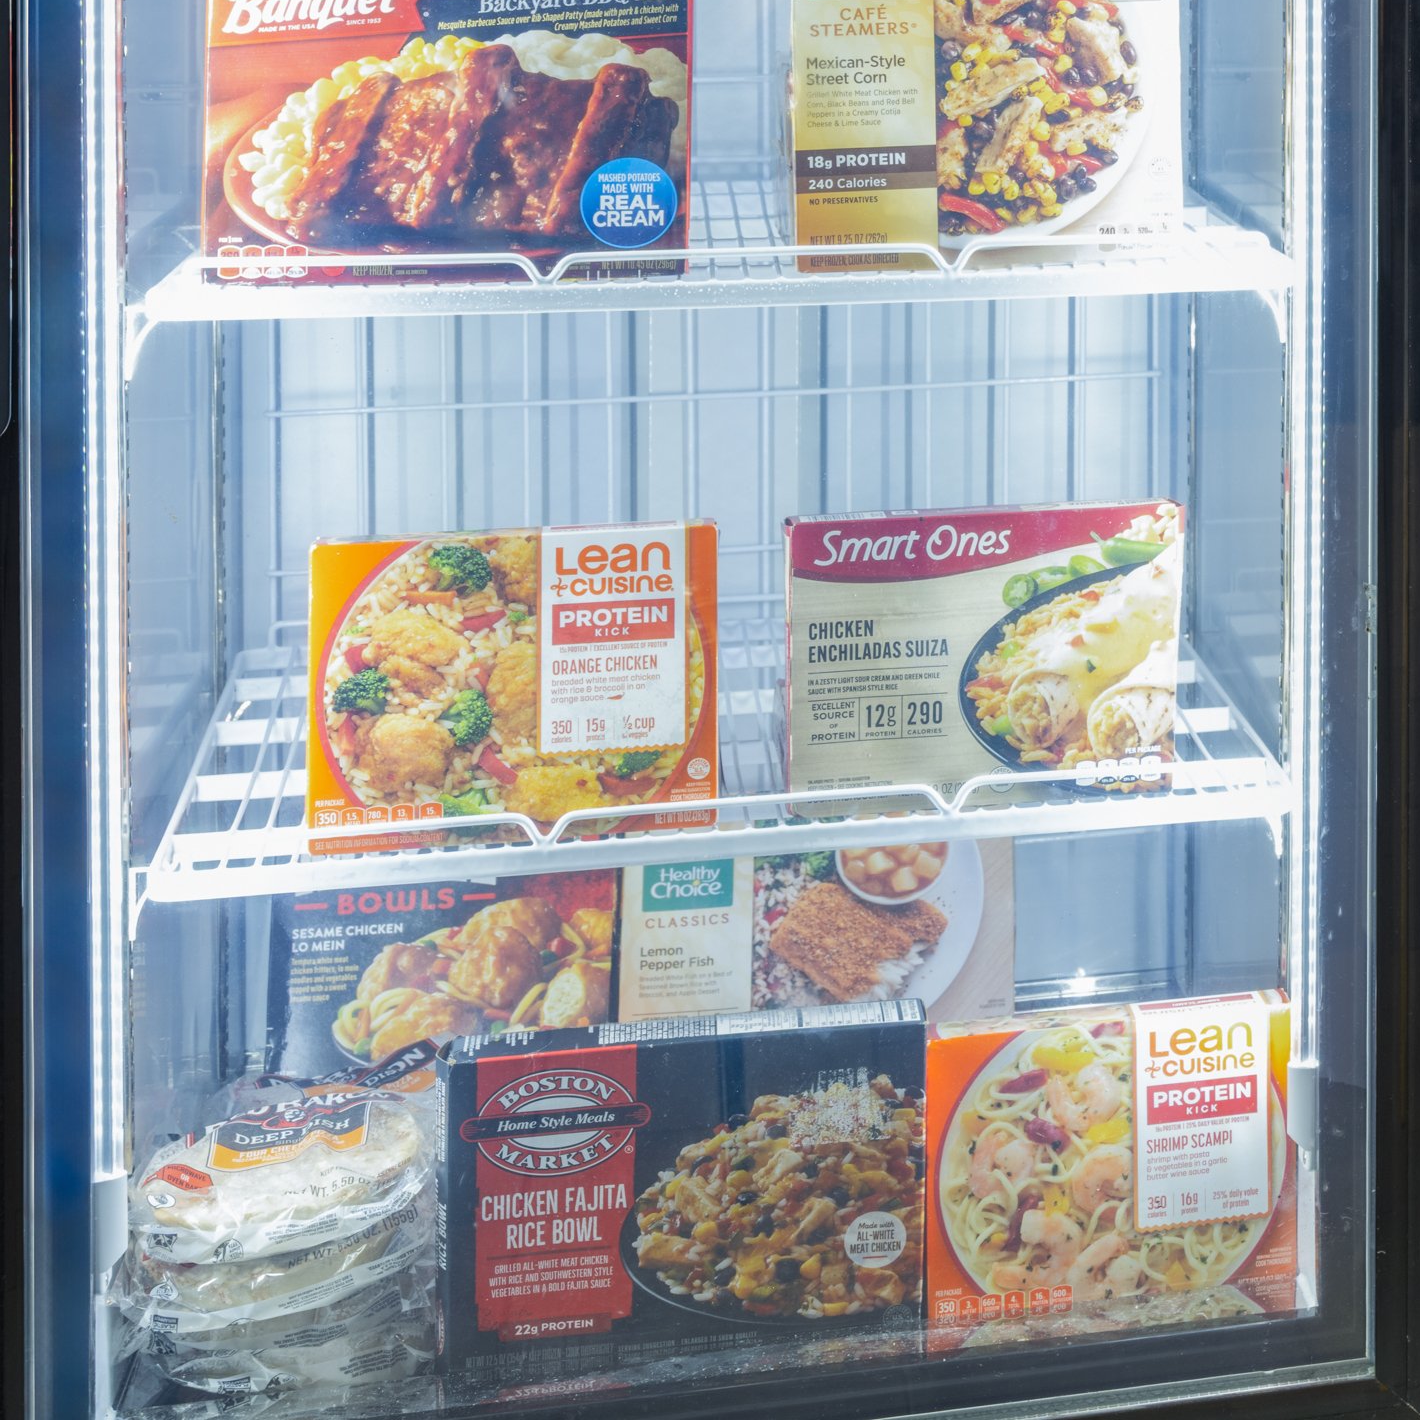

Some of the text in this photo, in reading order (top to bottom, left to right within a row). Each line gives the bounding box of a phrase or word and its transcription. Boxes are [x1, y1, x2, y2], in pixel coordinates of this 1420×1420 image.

[839, 4, 887, 21] CAFÉ
[809, 21, 909, 37] STEAMERS
[806, 55, 905, 70] Mexican-Style
[806, 72, 887, 86] Street Corn
[807, 153, 905, 170] 18g PROTEIN
[598, 173, 661, 184] MASHED POTATOES
[809, 177, 887, 190] 240 Calories
[602, 183, 653, 194] MADE WITH
[599, 195, 659, 212] REAL
[823, 196, 878, 205] PRESERVATIVES
[592, 209, 664, 228] CREAM
[814, 525, 1011, 567] Smart Ones
[555, 541, 672, 575] Lean
[570, 574, 672, 596] cuisine
[559, 605, 668, 628] PROTEIN
[594, 627, 630, 637] KICK
[808, 619, 874, 641] CHICKEN
[808, 639, 949, 664] ENCHILADAS SUIZA
[552, 654, 658, 676] ORANGE CHICKEN
[811, 701, 856, 711] EXCELLENT
[907, 701, 943, 726] 290
[813, 710, 855, 721] SOURCE
[865, 703, 896, 729] 12g
[552, 721, 572, 735] 350
[586, 719, 605, 733] 15g
[811, 732, 856, 742] PROTEIN
[661, 865, 720, 882] Healthy
[651, 881, 722, 899] Choice
[337, 888, 455, 916] BOWLS
[645, 913, 730, 929] CLASSICS
[291, 923, 403, 940] SESAME CHICKEN
[291, 940, 345, 953] LO MEIN
[640, 946, 683, 957] Lemon
[640, 956, 714, 971] Pepper Fish
[1149, 1021, 1253, 1058] Lean
[497, 1075, 616, 1111] BOSTON
[1153, 1082, 1251, 1108] PROTEIN
[1186, 1103, 1218, 1115] KICK
[497, 1110, 615, 1133] Home Style Meals
[1146, 1130, 1233, 1154] SHRIMP SCAMPI
[496, 1136, 615, 1172] MARKET
[481, 1182, 628, 1223] CHICKEN FAJITA
[506, 1215, 602, 1250] RICE BOWL
[874, 1240, 901, 1252] CHICKEN
[514, 1318, 594, 1336] 22g PROTEIN
